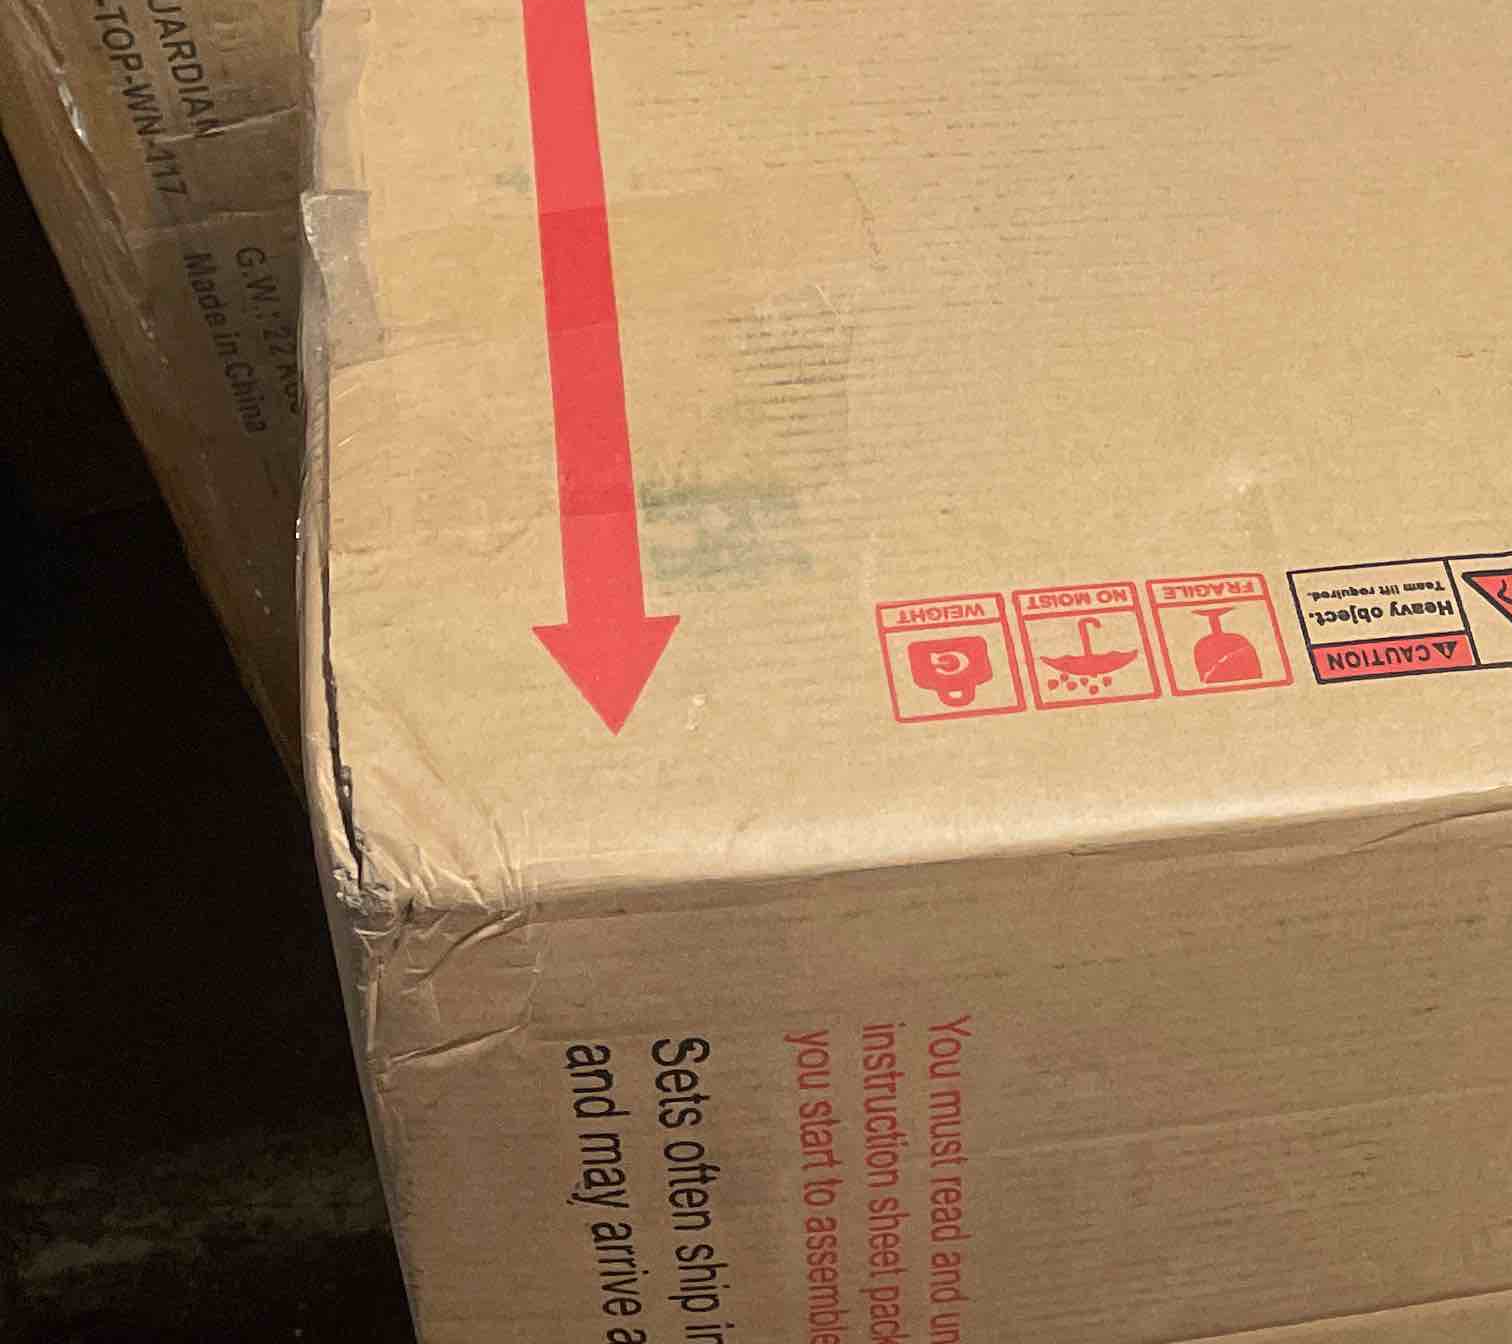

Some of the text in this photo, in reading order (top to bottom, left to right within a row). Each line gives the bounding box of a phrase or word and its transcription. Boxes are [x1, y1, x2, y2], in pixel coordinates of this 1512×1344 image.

[183, 252, 267, 436] Made in China
[895, 603, 987, 626] WEIGHT
[1025, 587, 1129, 612] NO MOIST
[1162, 579, 1257, 604] FRAGILE
[1306, 580, 1446, 602] Team lift required.
[1307, 599, 1455, 626] Heavy object.
[1325, 643, 1431, 671] CAUTION
[784, 1028, 832, 1091] you
[927, 1013, 972, 1079] You
[564, 1043, 631, 1120] and
[650, 1036, 711, 1131] Sets
[860, 1021, 906, 1190] instruction
[798, 1097, 838, 1171] start
[929, 1088, 969, 1162] must
[565, 1131, 630, 1210] may
[663, 1139, 722, 1233] often
[801, 1176, 839, 1208] to
[867, 1196, 911, 1274] sheet
[929, 1173, 972, 1243] read
[591, 1220, 648, 1317] arrive
[667, 1243, 729, 1314] ship
[929, 1249, 972, 1305] and
